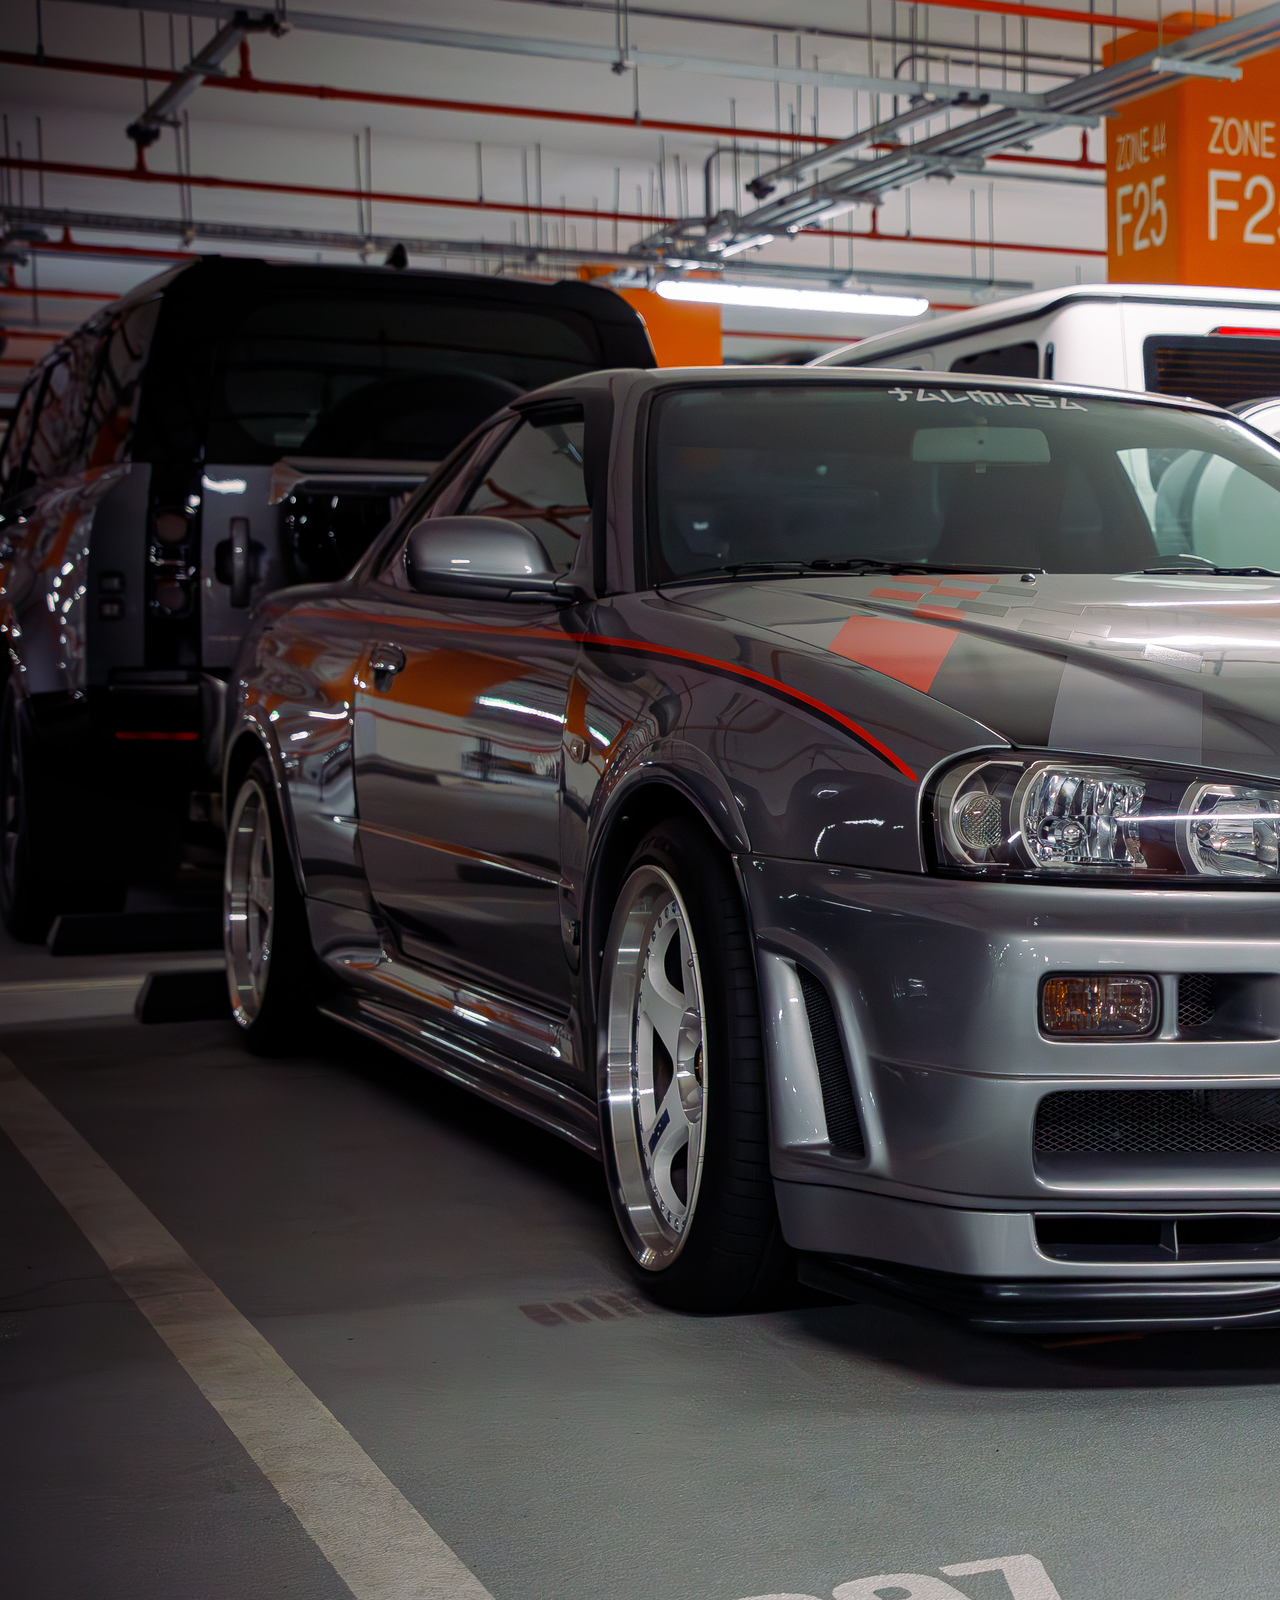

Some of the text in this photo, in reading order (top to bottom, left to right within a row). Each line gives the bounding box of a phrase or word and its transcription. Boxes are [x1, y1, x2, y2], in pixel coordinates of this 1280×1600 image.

[1115, 121, 1167, 172] ZONE 44
[1208, 115, 1276, 159] ZONE
[1116, 174, 1168, 256] F25
